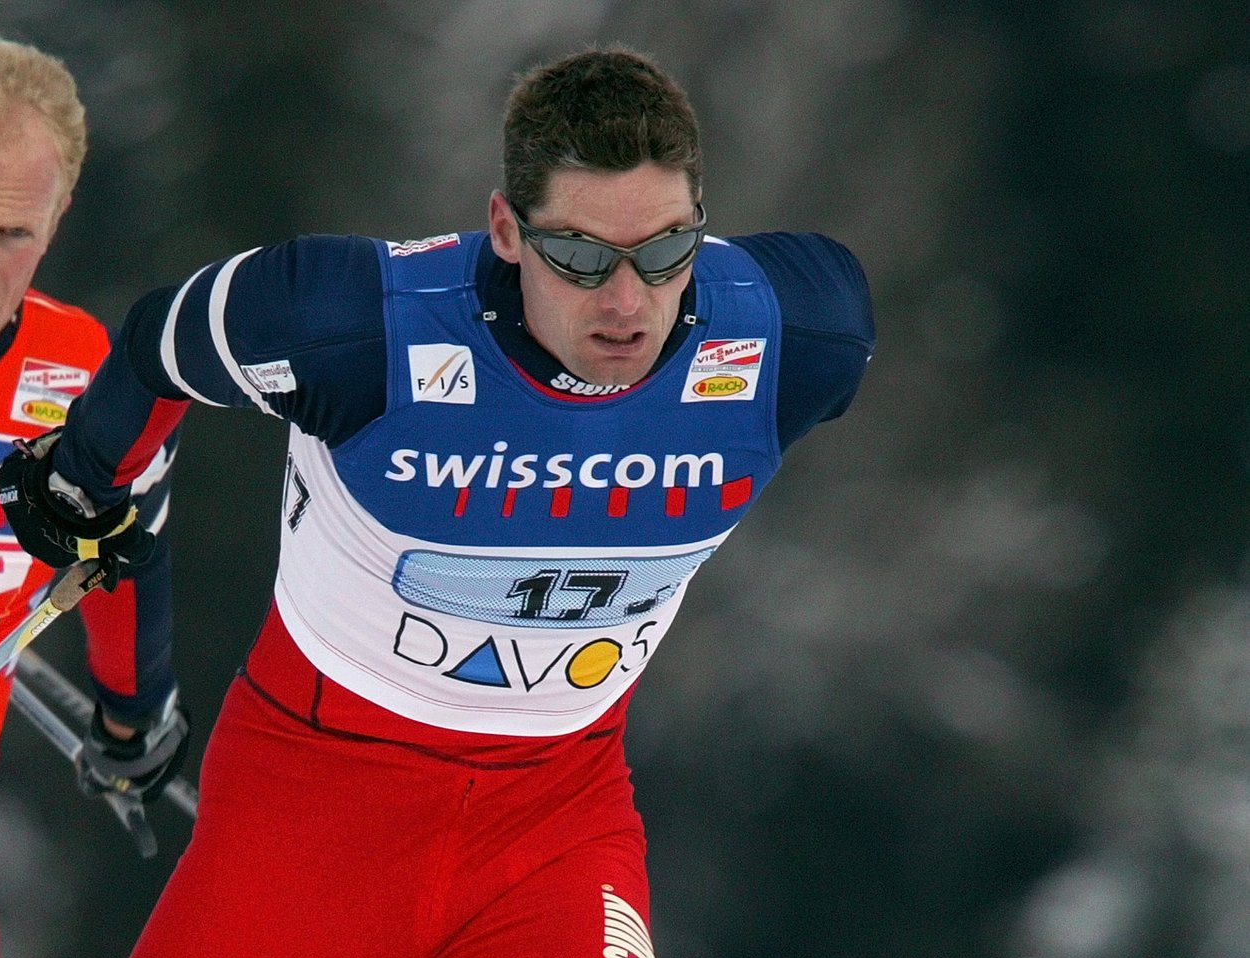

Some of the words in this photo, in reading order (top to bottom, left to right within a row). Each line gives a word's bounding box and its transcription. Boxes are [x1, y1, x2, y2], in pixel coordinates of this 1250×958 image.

[697, 341, 758, 363] VIESSMANN
[417, 375, 469, 391] FIS
[385, 441, 724, 489] swisscom
[393, 612, 658, 693] DAVOS
